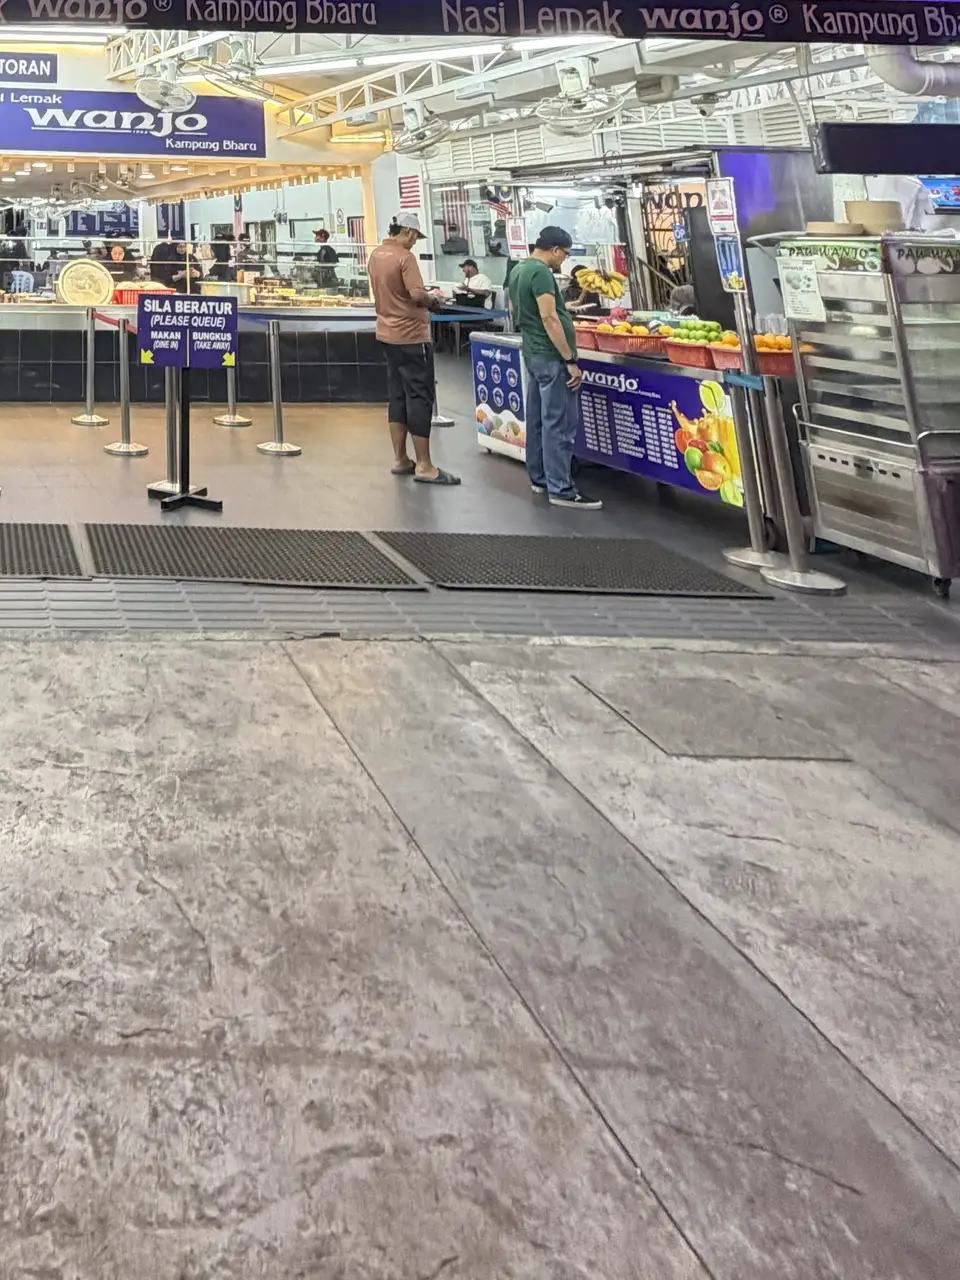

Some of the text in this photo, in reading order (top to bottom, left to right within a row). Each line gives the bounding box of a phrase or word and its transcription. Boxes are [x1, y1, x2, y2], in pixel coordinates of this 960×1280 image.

[640, 2, 765, 38] wanjo
[802, 3, 918, 42] Kampung
[10, 92, 62, 104] Lemak
[23, 108, 208, 137] wanjo
[166, 138, 257, 152] Kampung Bharu
[144, 299, 232, 315] SILA BERATUR
[151, 315, 226, 330] (PLEASE QUEUE)
[151, 331, 181, 340] MAKAN
[192, 332, 232, 341] BUNGKUS
